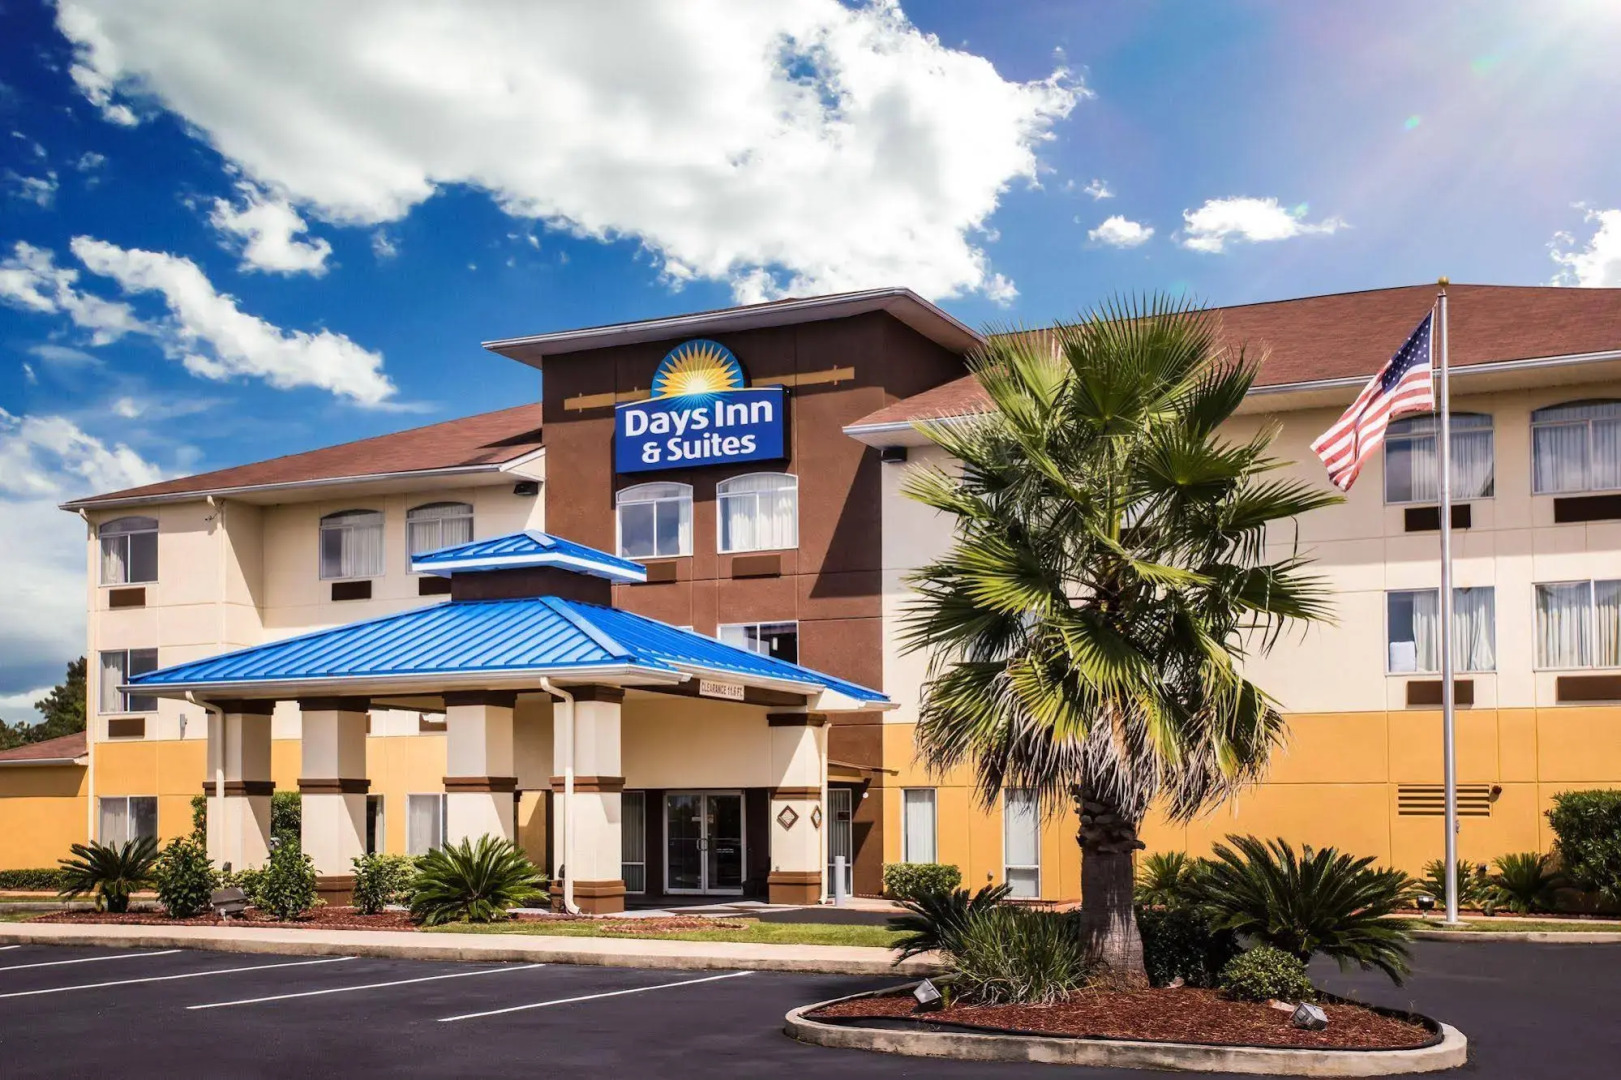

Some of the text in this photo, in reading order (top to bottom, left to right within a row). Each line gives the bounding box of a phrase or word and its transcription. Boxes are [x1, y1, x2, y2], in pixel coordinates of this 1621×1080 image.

[625, 400, 773, 437] Days Inn
[641, 432, 757, 464] & Suites
[701, 682, 727, 695] CLEARANCE
